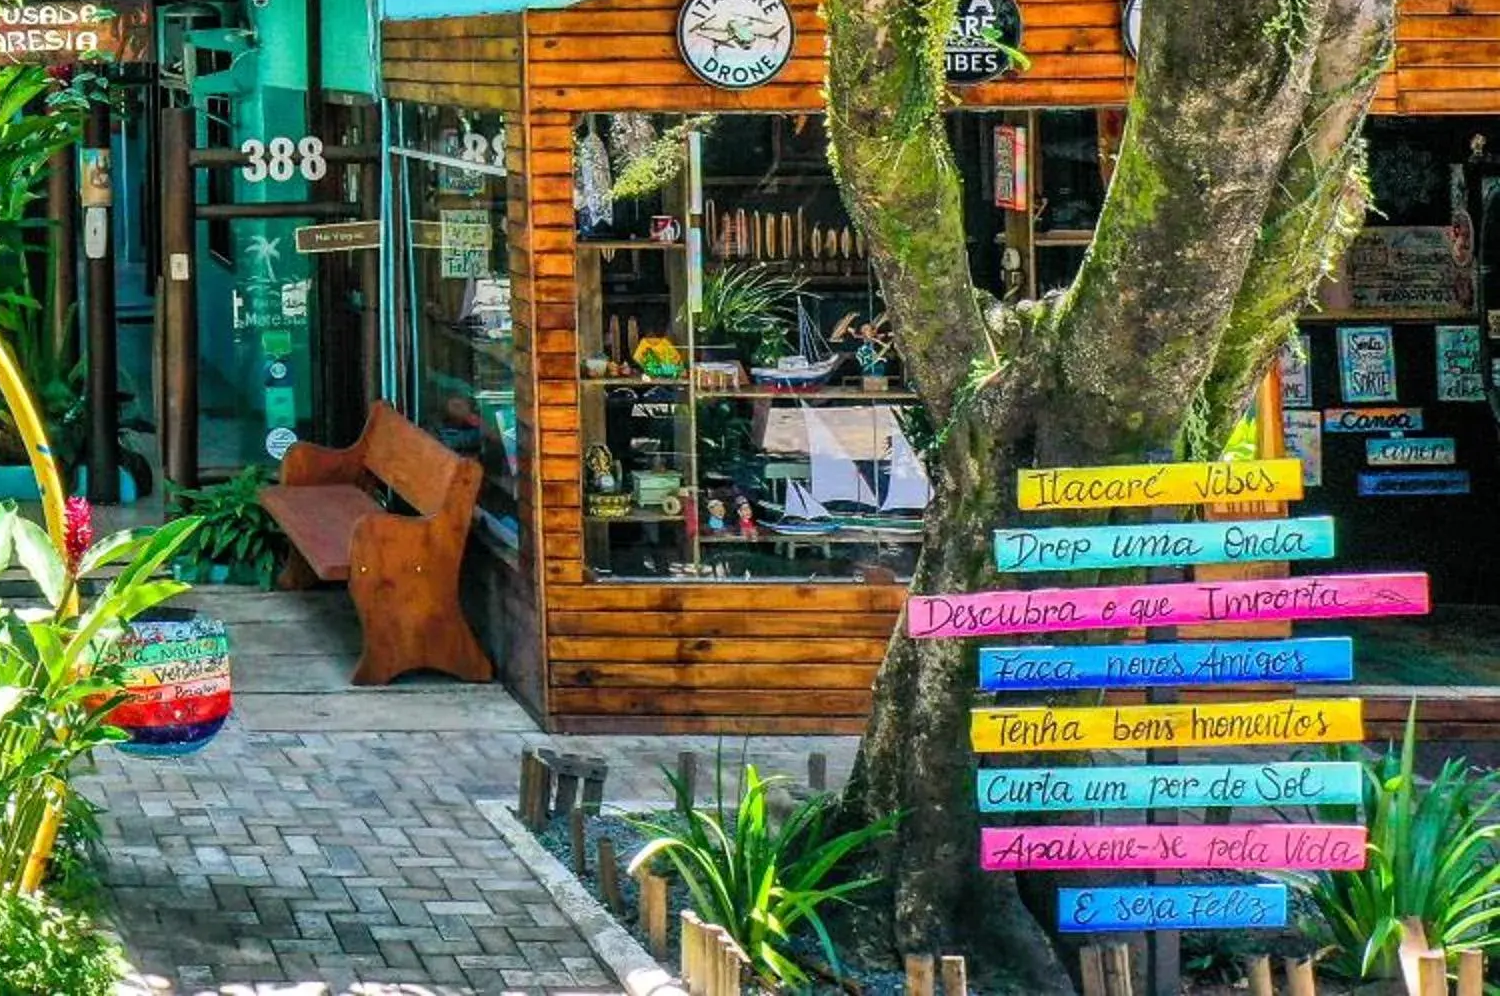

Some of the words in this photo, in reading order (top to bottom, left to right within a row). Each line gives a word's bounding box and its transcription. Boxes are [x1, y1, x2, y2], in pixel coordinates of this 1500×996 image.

[703, 55, 777, 83] DRONE
[945, 54, 999, 73] IBES
[241, 136, 327, 182] 388
[1028, 468, 1163, 507] Itacaré
[1007, 533, 1092, 570] Drop
[1112, 532, 1203, 559] uma
[1223, 525, 1311, 559] Onda
[915, 595, 1086, 636] Descubra
[1102, 601, 1117, 621] o
[1129, 597, 1175, 624] que
[1197, 579, 1349, 620] Importa
[1107, 650, 1185, 678] novos
[1194, 647, 1307, 680] Amigos
[989, 711, 1085, 746] Tenha
[1113, 709, 1176, 741] bons
[1191, 705, 1332, 740] momentos
[986, 771, 1076, 805] Curta
[1083, 780, 1129, 802] um
[1150, 776, 1200, 805] por
[1255, 767, 1326, 802] Sol
[1207, 830, 1270, 865] pela
[1285, 831, 1360, 864] Vida
[1073, 892, 1100, 925] E
[1115, 893, 1180, 925] seja
[1186, 890, 1274, 925] Feliz
